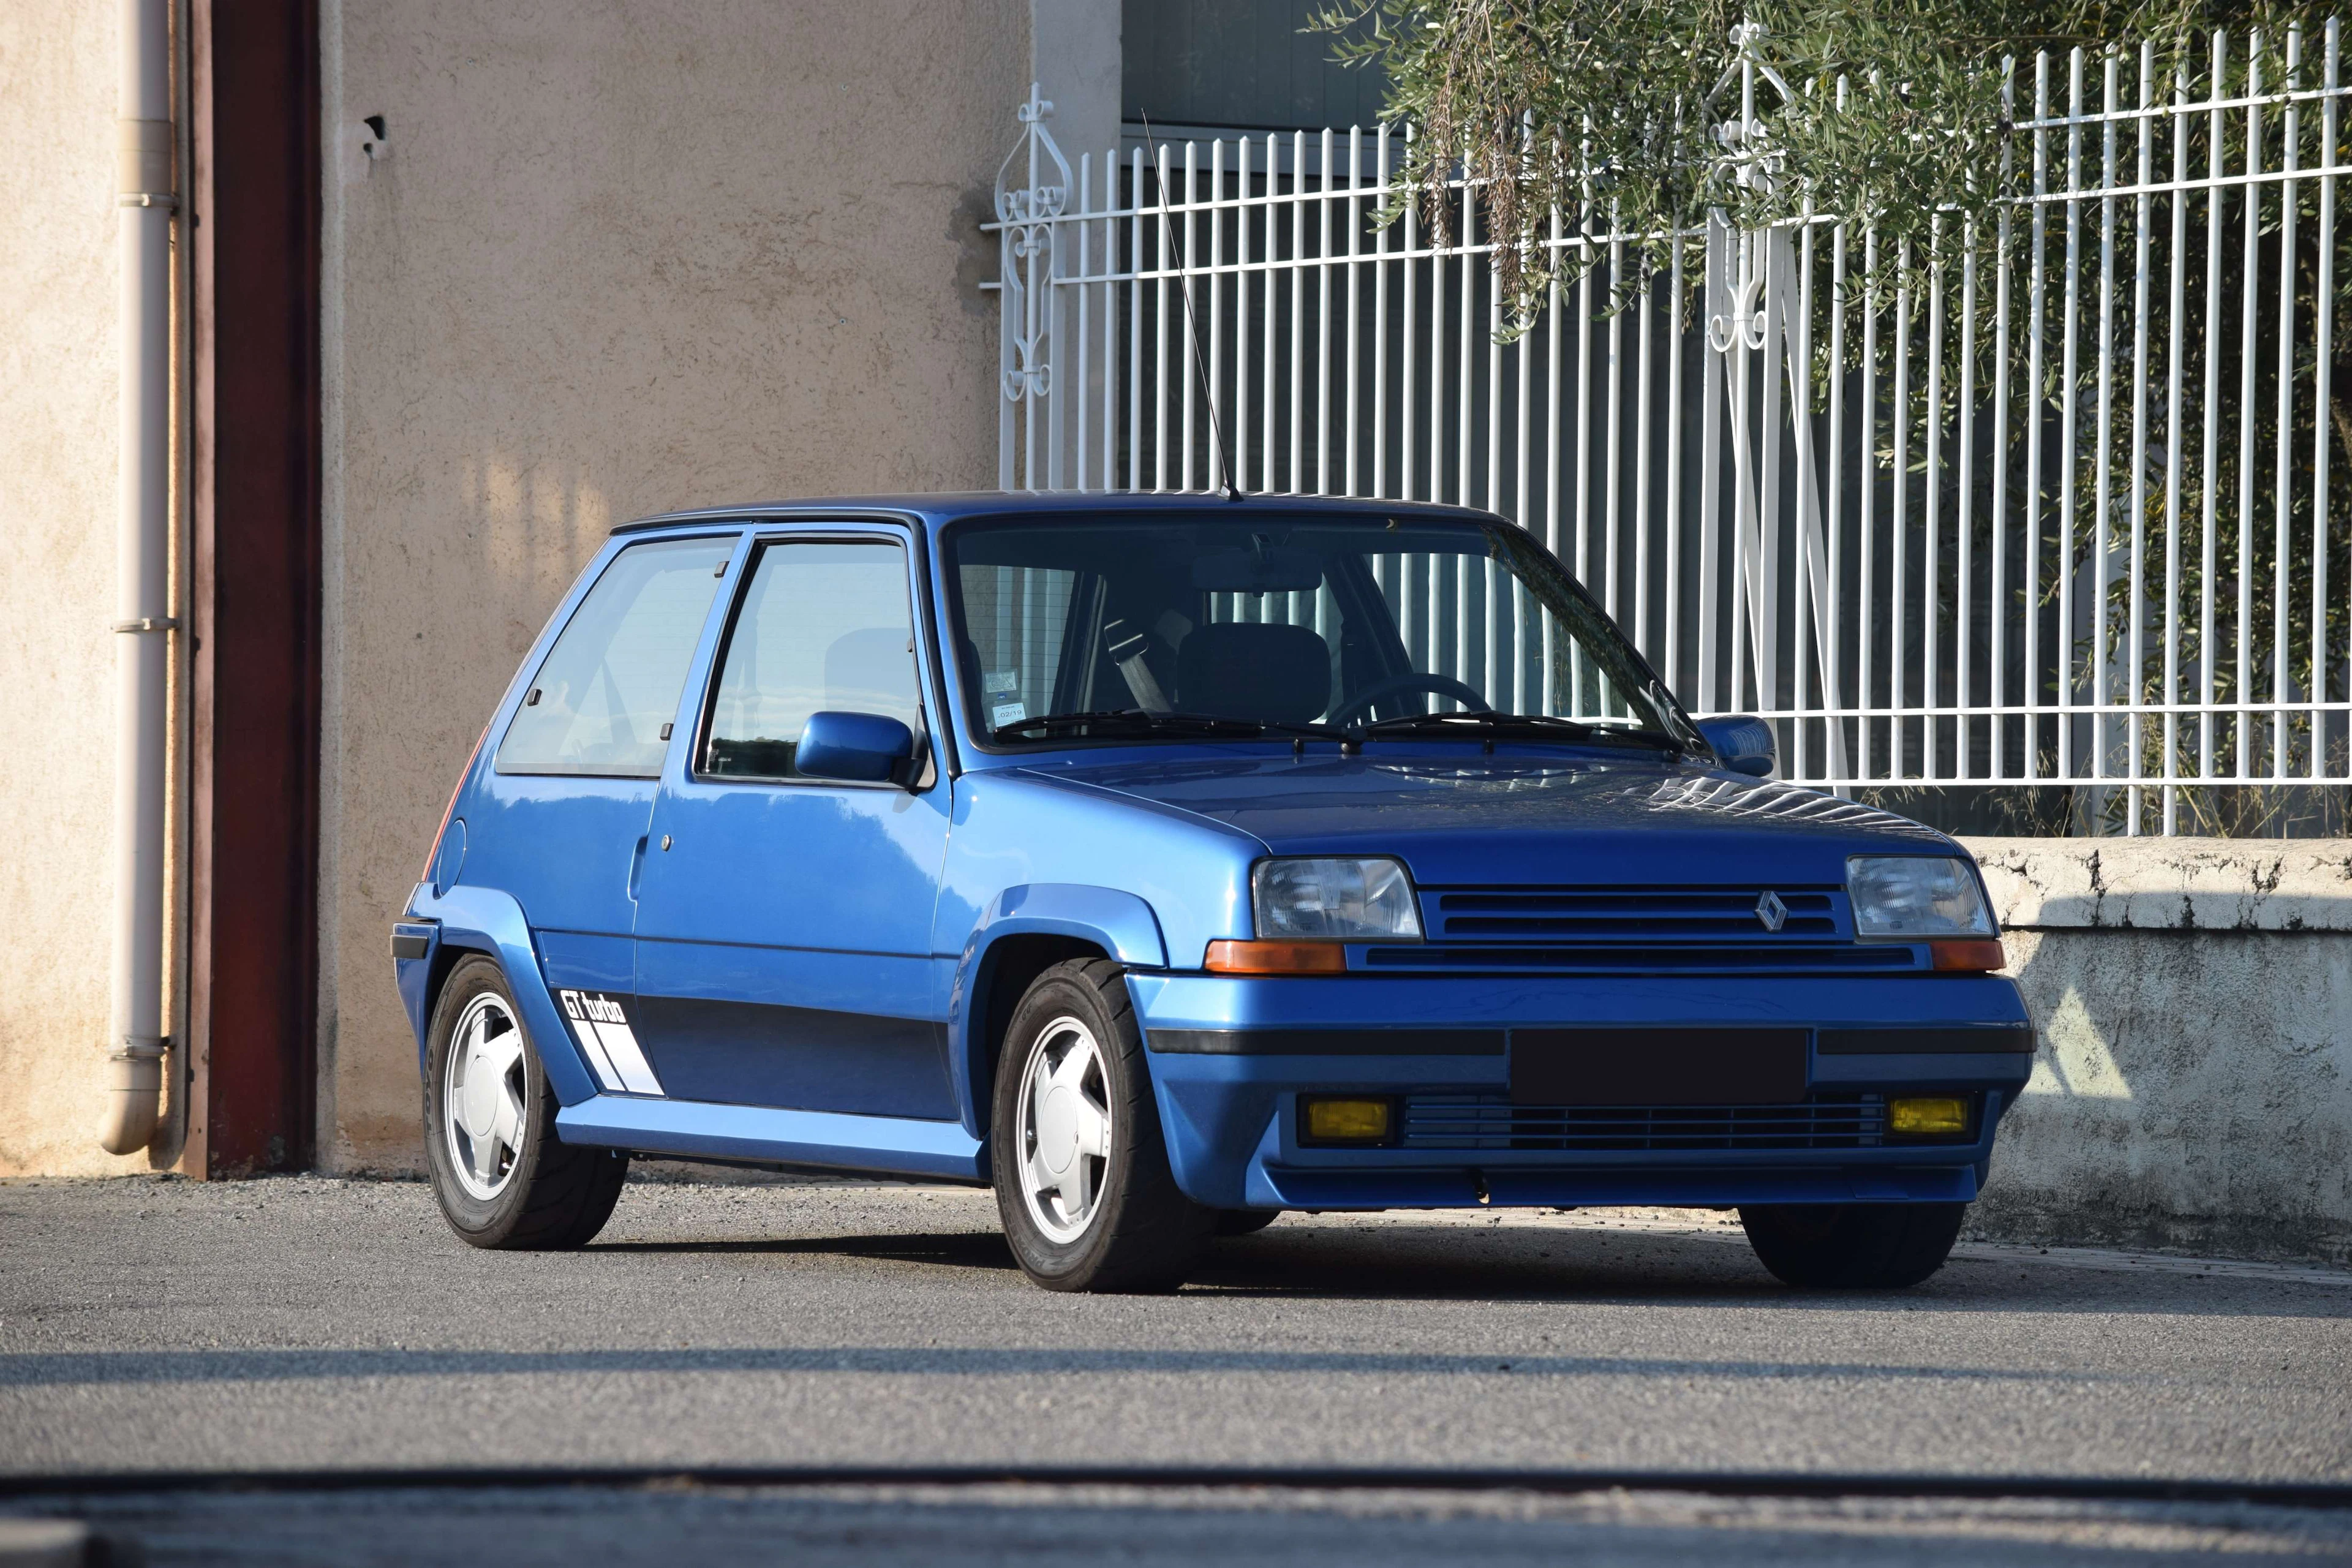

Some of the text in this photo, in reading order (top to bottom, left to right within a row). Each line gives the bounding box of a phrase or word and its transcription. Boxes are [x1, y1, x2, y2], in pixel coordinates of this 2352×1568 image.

[560, 990, 627, 1023] GT turbo
[425, 1048, 434, 1136] TOYO
